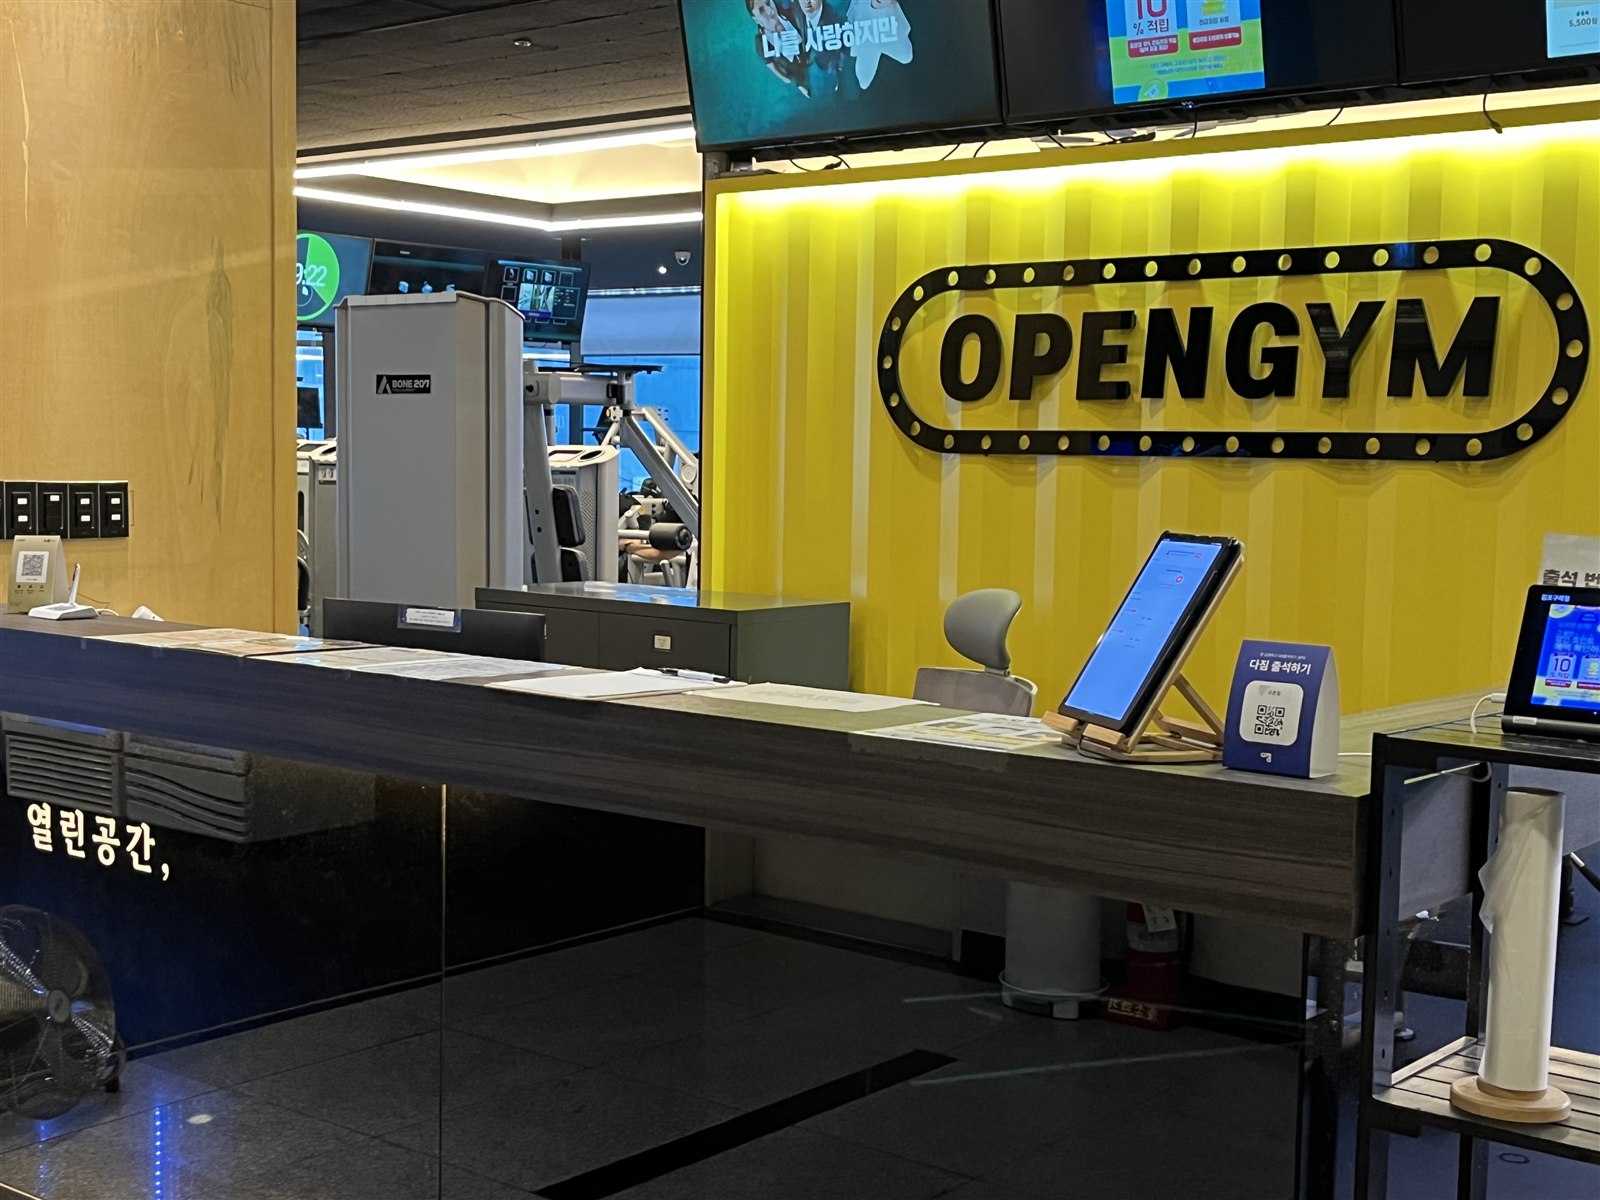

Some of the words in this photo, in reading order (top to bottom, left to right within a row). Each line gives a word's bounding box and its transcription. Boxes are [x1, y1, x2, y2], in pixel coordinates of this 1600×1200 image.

[1133, 22, 1144, 36] %
[1147, 18, 1169, 33] 적립
[761, 30, 800, 58] 나를
[805, 15, 898, 52] 사랑하지만
[939, 295, 1502, 403] OPENGYM
[392, 379, 413, 388] BONE
[413, 379, 430, 388] 207
[1249, 659, 1269, 671] 다짐
[1271, 661, 1311, 675] 출석하기
[1554, 658, 1571, 672] 10
[27, 802, 170, 881] 열린공간,
